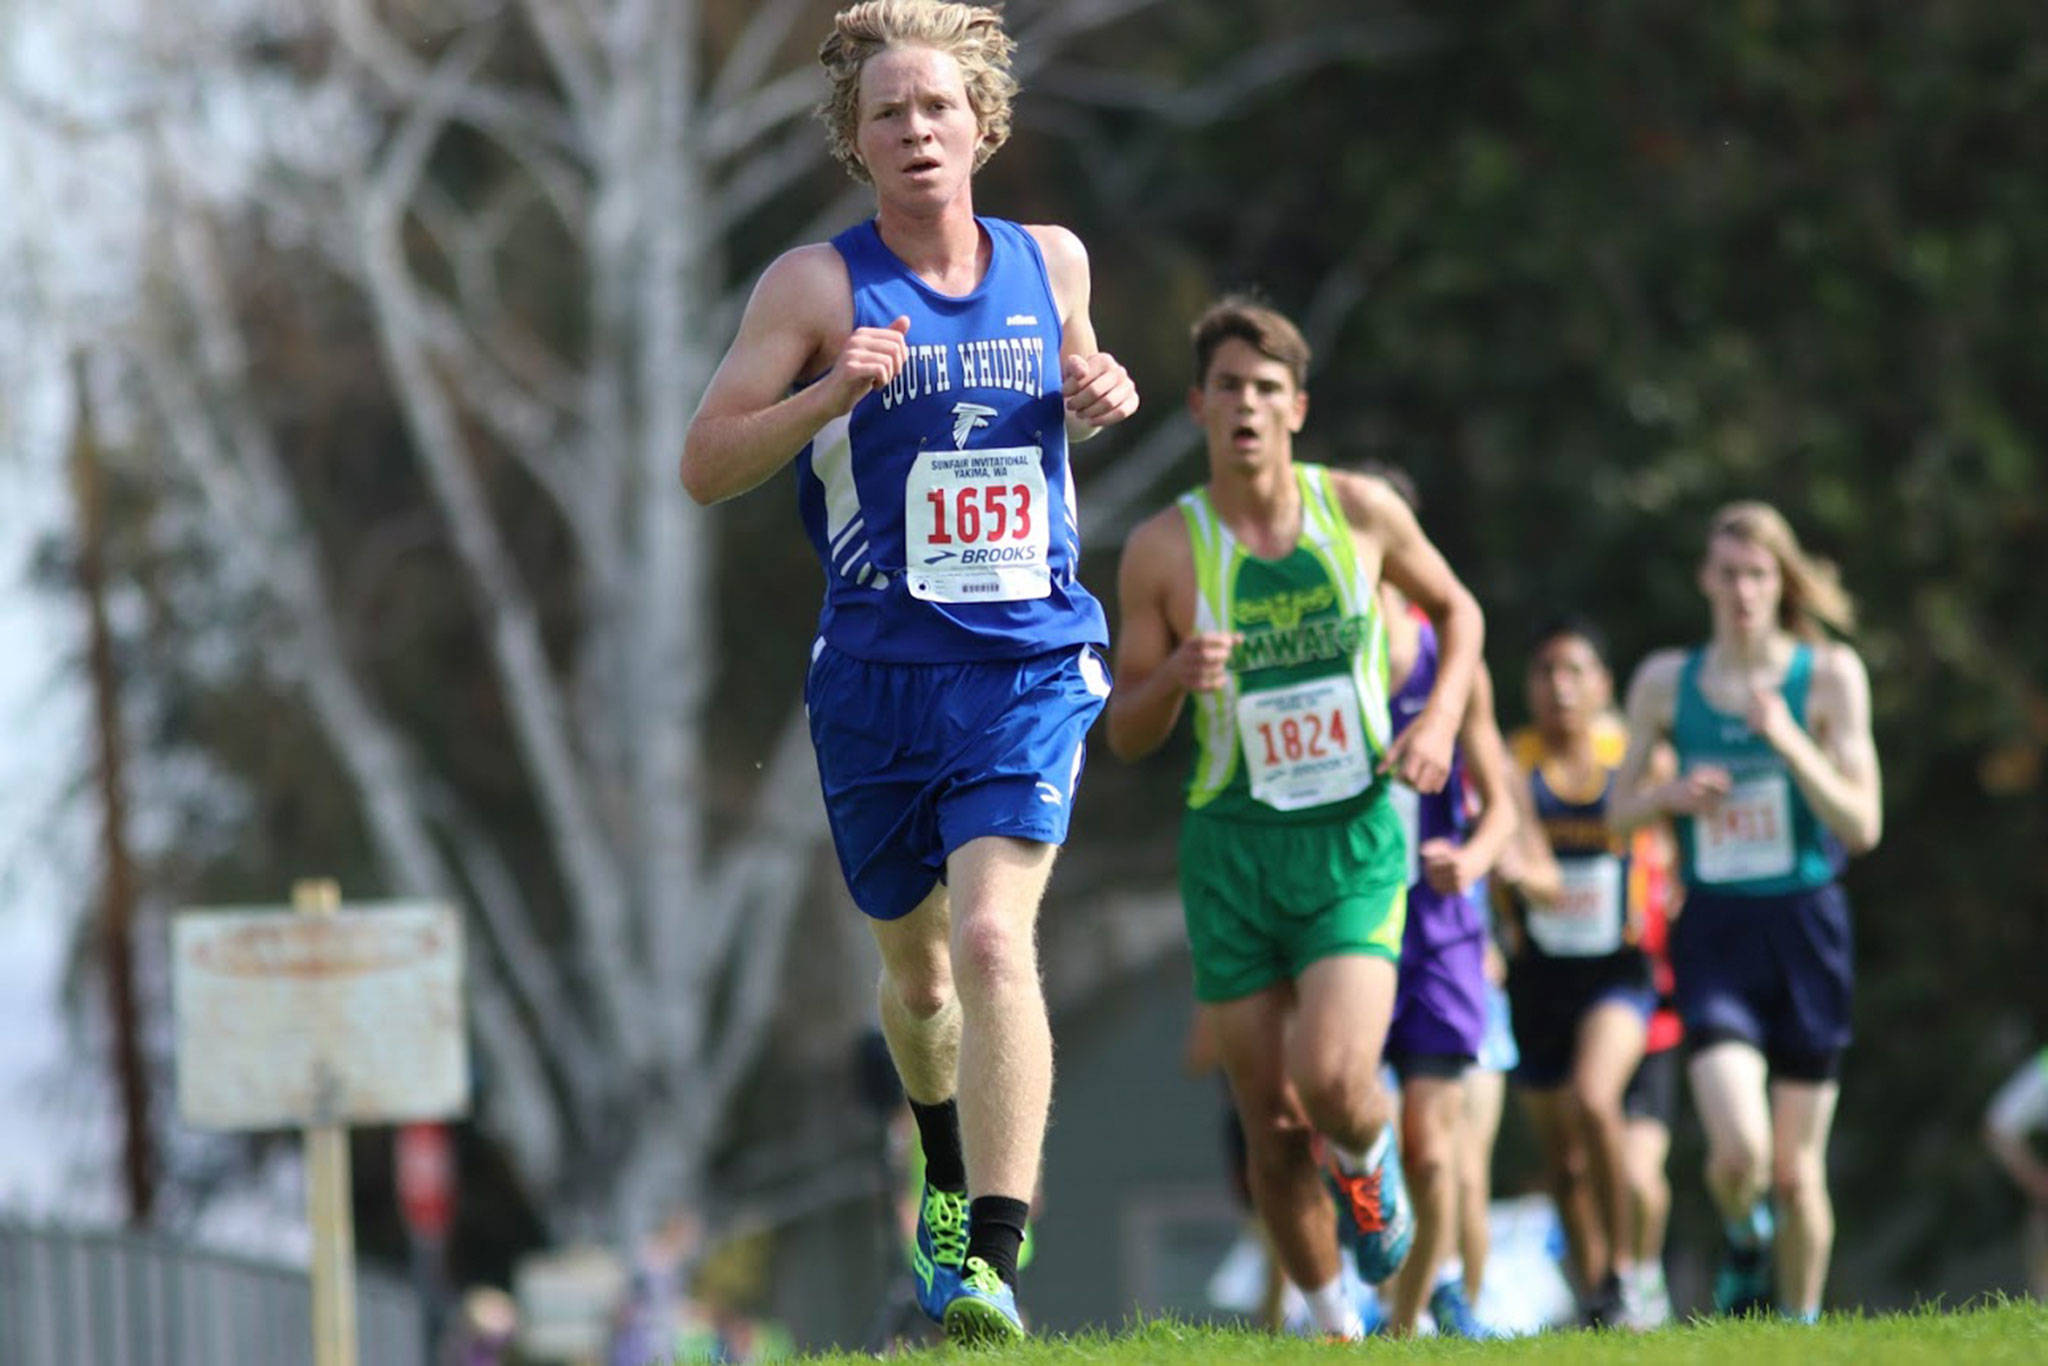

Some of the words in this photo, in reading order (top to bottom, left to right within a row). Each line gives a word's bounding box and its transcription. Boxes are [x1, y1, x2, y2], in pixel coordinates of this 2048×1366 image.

[957, 337, 1044, 400] WHIDBEY
[931, 458, 969, 470] SUNFAIR
[971, 455, 1029, 467] INVITATIONAL
[954, 466, 990, 478] YAKIMA,
[993, 466, 1008, 476] WA
[927, 484, 1031, 544] 1653
[961, 545, 1036, 564] BROOKS
[1257, 708, 1349, 766] 1824
